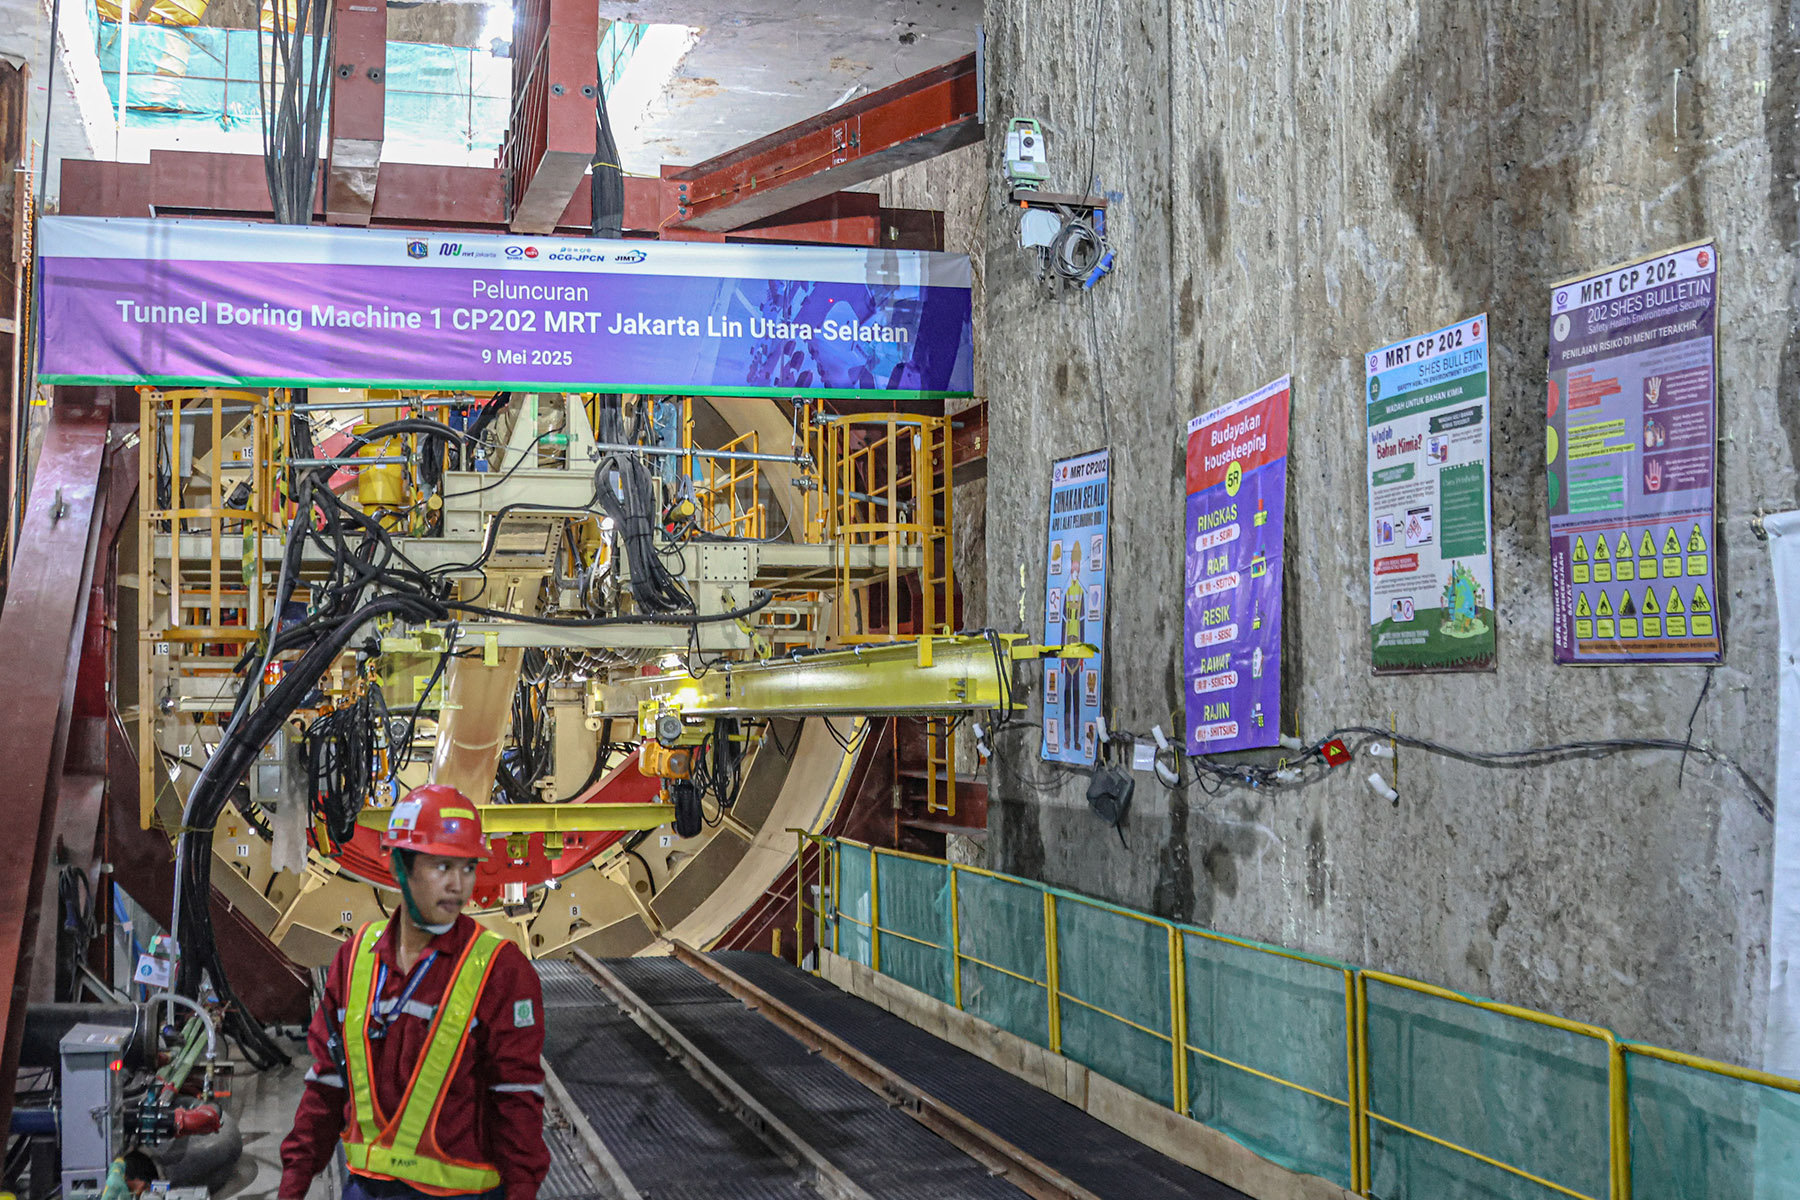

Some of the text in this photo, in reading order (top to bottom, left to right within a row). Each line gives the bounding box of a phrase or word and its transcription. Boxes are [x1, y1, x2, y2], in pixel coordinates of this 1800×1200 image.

[548, 253, 605, 262] OCG-JPCN
[472, 280, 588, 302] Peluncuran
[1580, 259, 1677, 304] MRT CP 202
[1587, 277, 1711, 325] 202 SHES BULLETIN
[116, 300, 909, 344] Tunnel Boring Machine 1 CP202 MRT Jakarta Lin Utara-Selatan
[1588, 322, 1609, 335] Safety
[1610, 316, 1631, 329] Health
[1679, 297, 1711, 313] Security
[1386, 329, 1463, 368] MRT CP 202
[1562, 320, 1698, 360] PENILAIAN RISIKO DI MENIT TERAKHIR
[482, 349, 573, 366] 9 Mei 2025
[1419, 348, 1482, 378] SHES BULLETIN
[1386, 386, 1463, 414] WADAH UNTUK BAHAN KIMIA
[1211, 414, 1261, 447] Budayakan
[1372, 426, 1393, 445] Wadah
[1204, 433, 1267, 472] Housekeeping
[1377, 434, 1422, 460] Bahan Kimia?
[1070, 459, 1107, 479] MRT CP202
[1083, 483, 1106, 509] SELALU
[1198, 504, 1238, 533] RINGKAS
[1207, 554, 1229, 577] RAPI
[1203, 604, 1231, 626] RESIK
[159, 644, 169, 654] 13
[1201, 653, 1231, 674] RAWAT
[1203, 702, 1230, 721] RAJIN
[237, 845, 246, 856] 11
[342, 912, 352, 922] 10
